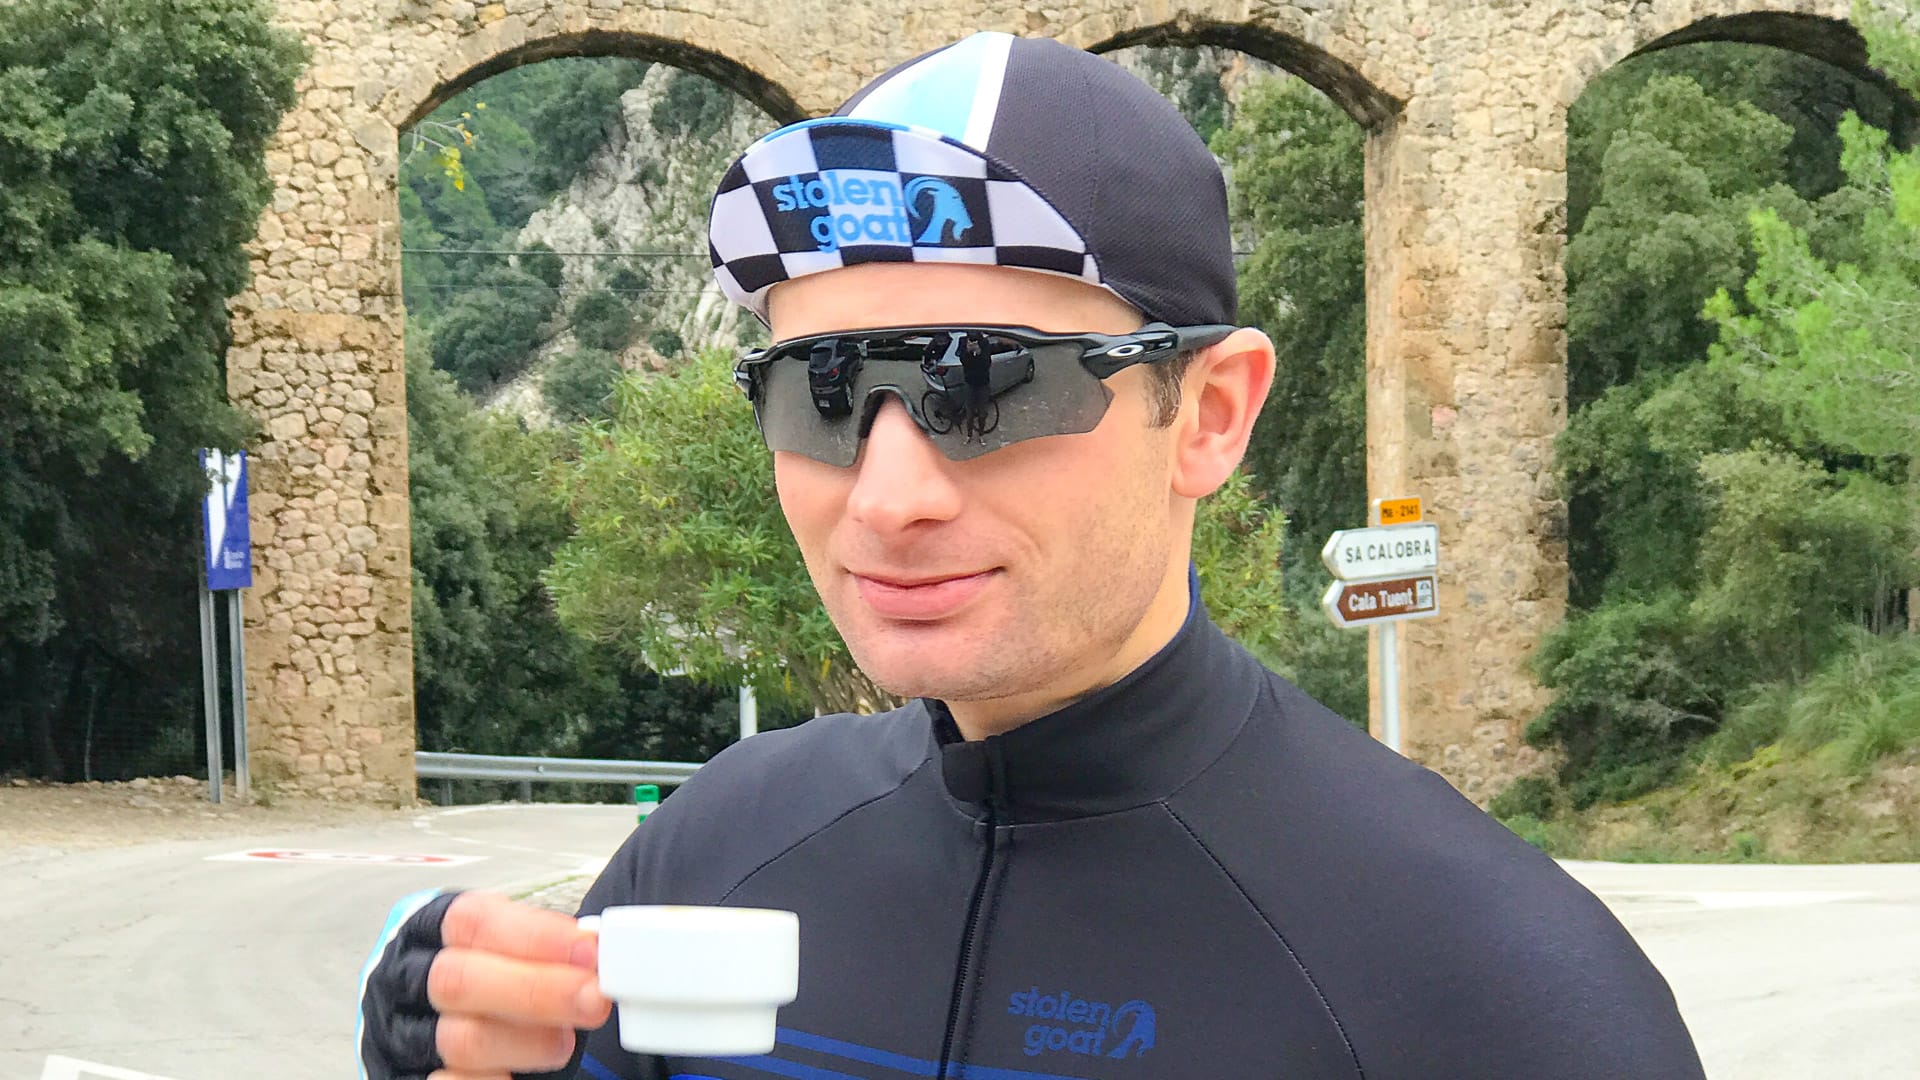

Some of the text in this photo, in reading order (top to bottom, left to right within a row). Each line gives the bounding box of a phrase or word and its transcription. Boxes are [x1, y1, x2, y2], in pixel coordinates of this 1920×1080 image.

[773, 171, 901, 211] stolen
[810, 208, 910, 253] goat
[1346, 540, 1431, 563] SA CALOBRA
[1348, 587, 1413, 612] Cala Tuent
[1008, 986, 1110, 1026] stolen
[1023, 1024, 1106, 1056] goat
